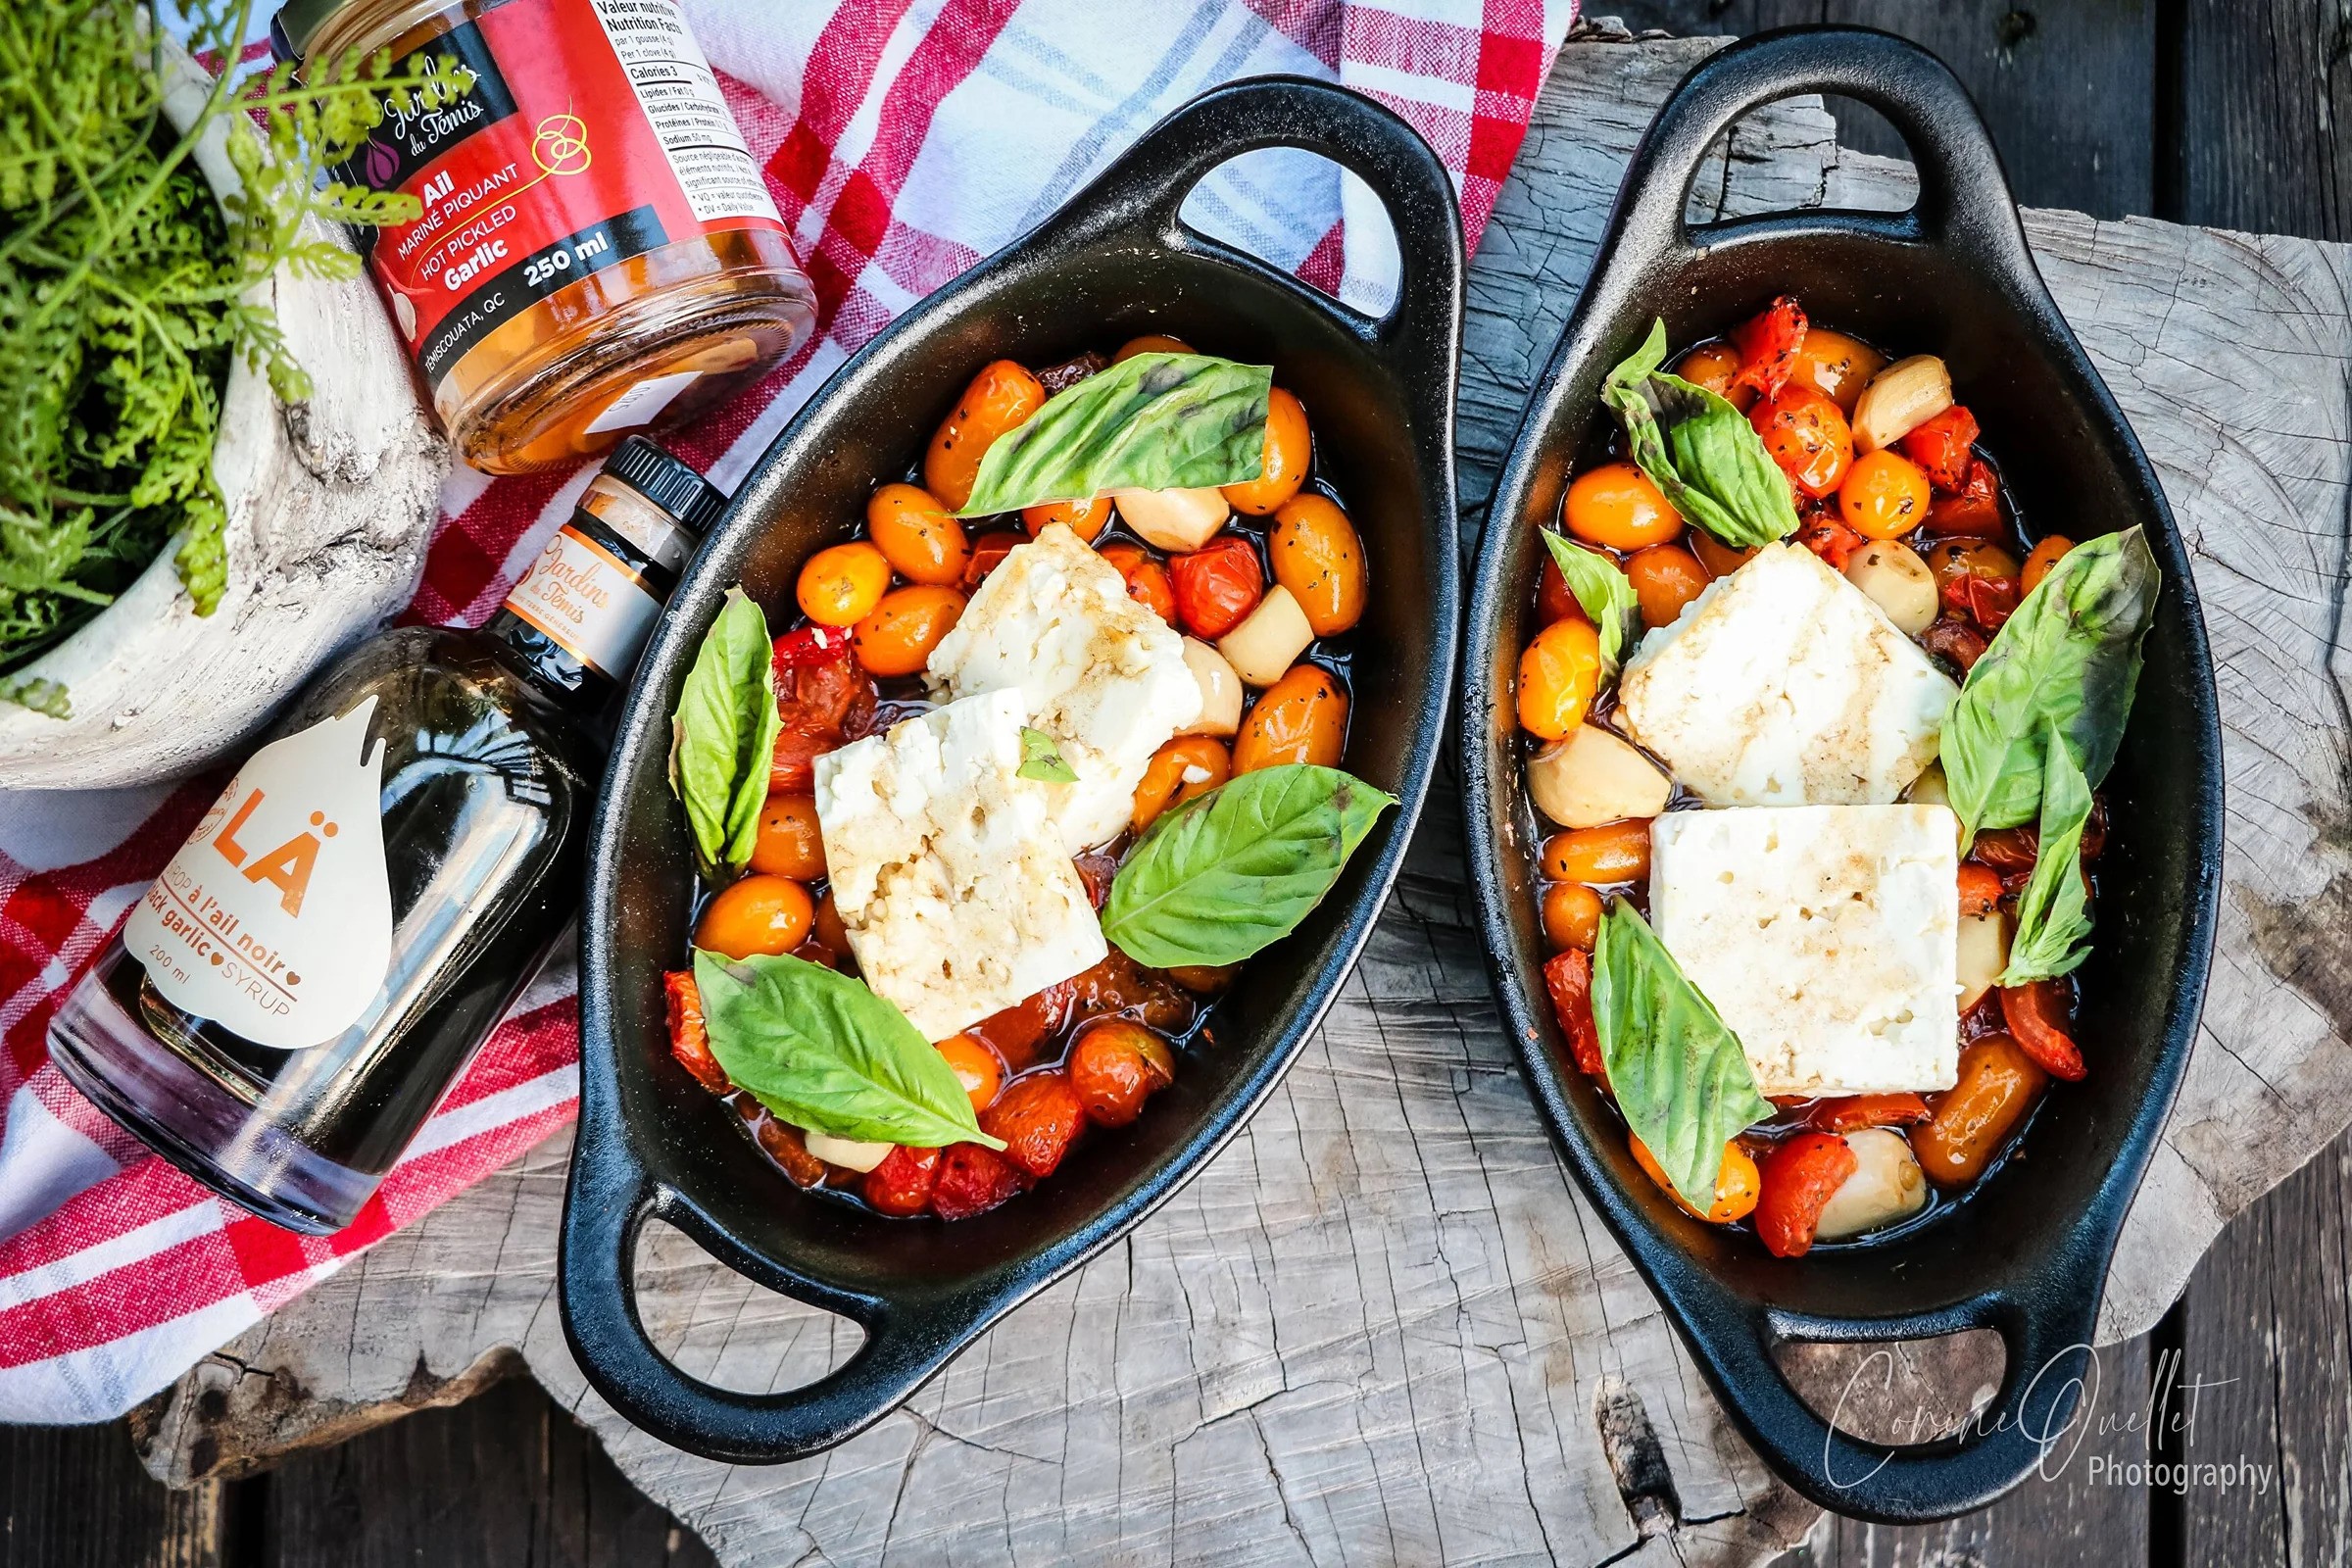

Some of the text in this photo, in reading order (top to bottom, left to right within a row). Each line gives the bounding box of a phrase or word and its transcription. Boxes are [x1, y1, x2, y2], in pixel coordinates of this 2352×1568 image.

[597, 0, 677, 20] Valeur nutritive
[606, 16, 683, 35] Nutrition Facts
[614, 36, 628, 47] par
[635, 35, 661, 45] gousse
[620, 50, 635, 60] Per
[642, 48, 662, 58] clove
[630, 66, 678, 79] Calories 3
[639, 86, 668, 99] Lipides
[672, 86, 683, 96] Fat
[648, 103, 681, 115] Glucides
[410, 99, 484, 157] du Témis
[655, 118, 691, 129] Protéines
[662, 134, 692, 146] Sodium
[672, 154, 699, 164] Source
[679, 164, 712, 176] éléments
[422, 169, 456, 209] Ail
[685, 175, 722, 189] significant
[697, 191, 710, 202] VQ
[397, 162, 519, 262] MARINÉ PIQUANT
[704, 205, 715, 215] DV
[721, 203, 739, 214] Daily
[420, 204, 516, 282] HOT PICKLED
[444, 239, 509, 292] Garlic
[522, 230, 610, 288] 250 ml
[424, 292, 506, 374] TÉMISCOUATA, QC
[541, 581, 585, 624] Témis
[213, 787, 339, 919] LÄ
[188, 884, 202, 904] à
[200, 896, 239, 936] l'ail
[237, 933, 286, 974] noir
[149, 944, 191, 985] 200 ml
[162, 909, 212, 956] garlic
[221, 961, 290, 1015] SYRUP
